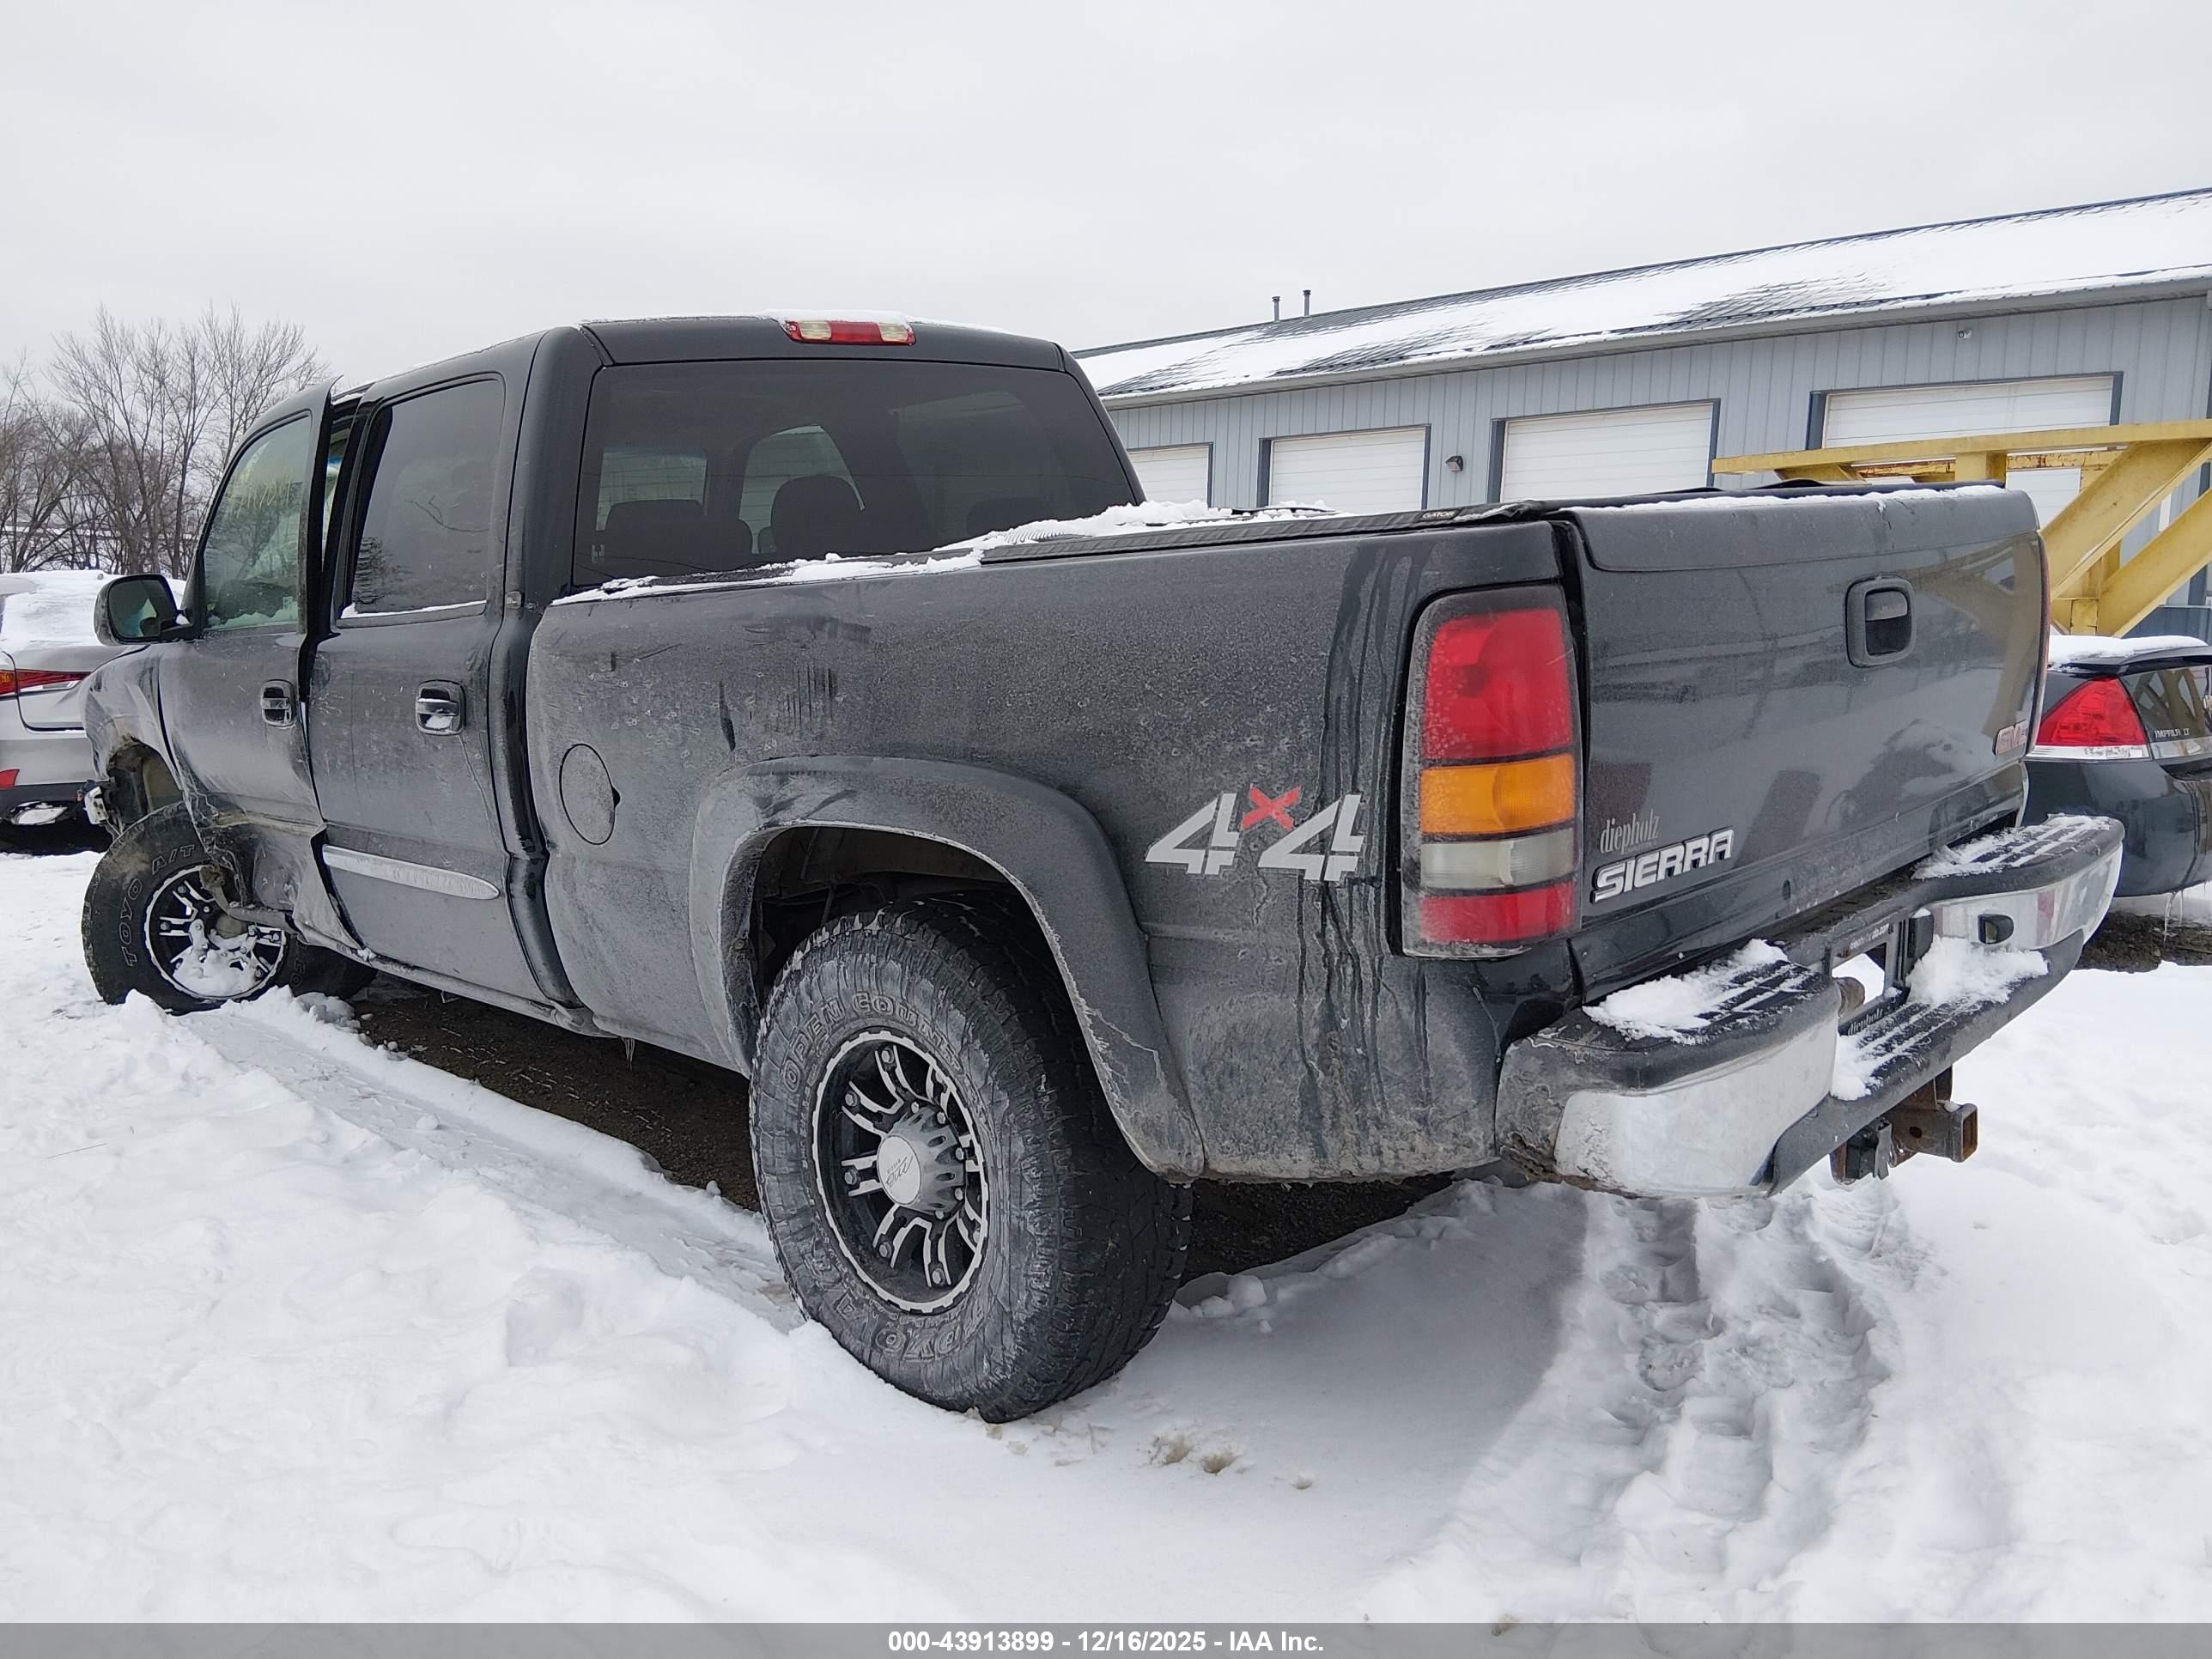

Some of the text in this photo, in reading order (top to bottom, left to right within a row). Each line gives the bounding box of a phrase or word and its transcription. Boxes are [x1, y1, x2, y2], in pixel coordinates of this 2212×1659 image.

[1421, 510, 1456, 520] GATOR
[2154, 727, 2181, 738] IMPALA
[1600, 809, 1660, 855] diepholz
[1591, 826, 1735, 903] SIERRA
[118, 844, 196, 967] TOYO A/T
[781, 996, 846, 1093] OPEN
